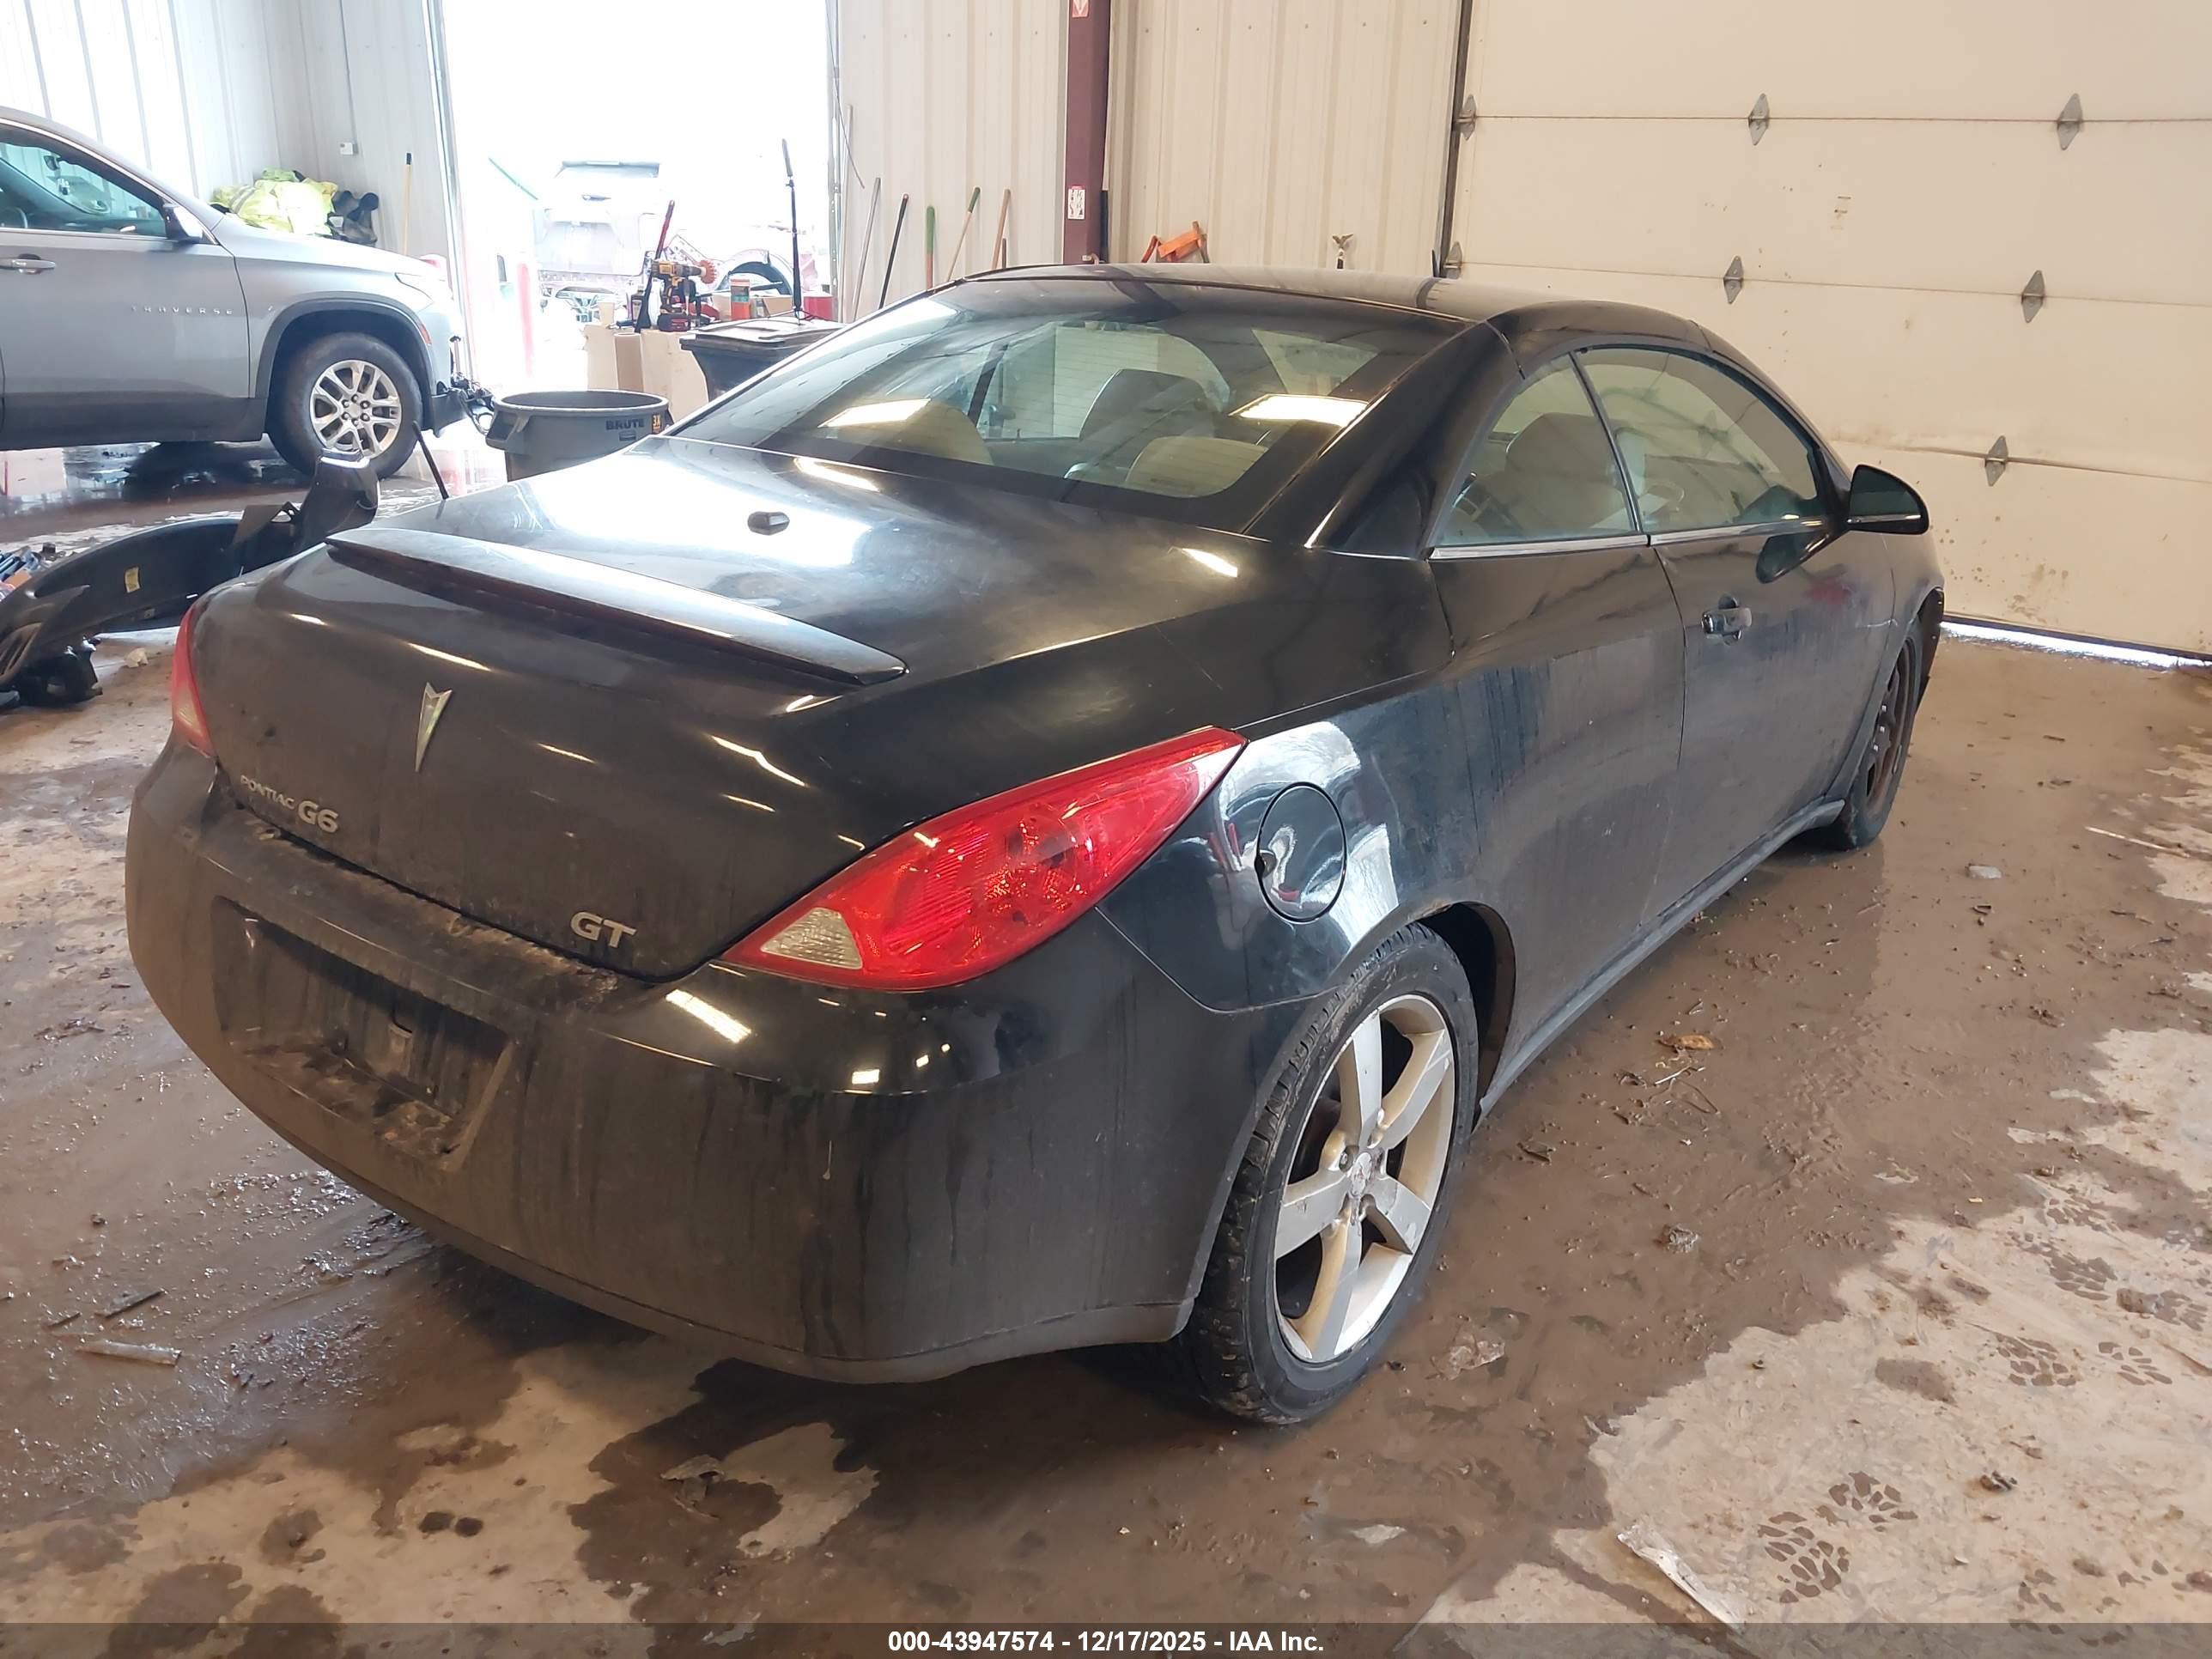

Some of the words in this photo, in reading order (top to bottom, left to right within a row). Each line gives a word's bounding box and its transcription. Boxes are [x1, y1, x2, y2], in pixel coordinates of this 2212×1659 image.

[606, 419, 645, 430] BRUTE
[240, 774, 295, 810] PONTIAC
[298, 799, 339, 834] G6
[570, 911, 636, 949] GT
